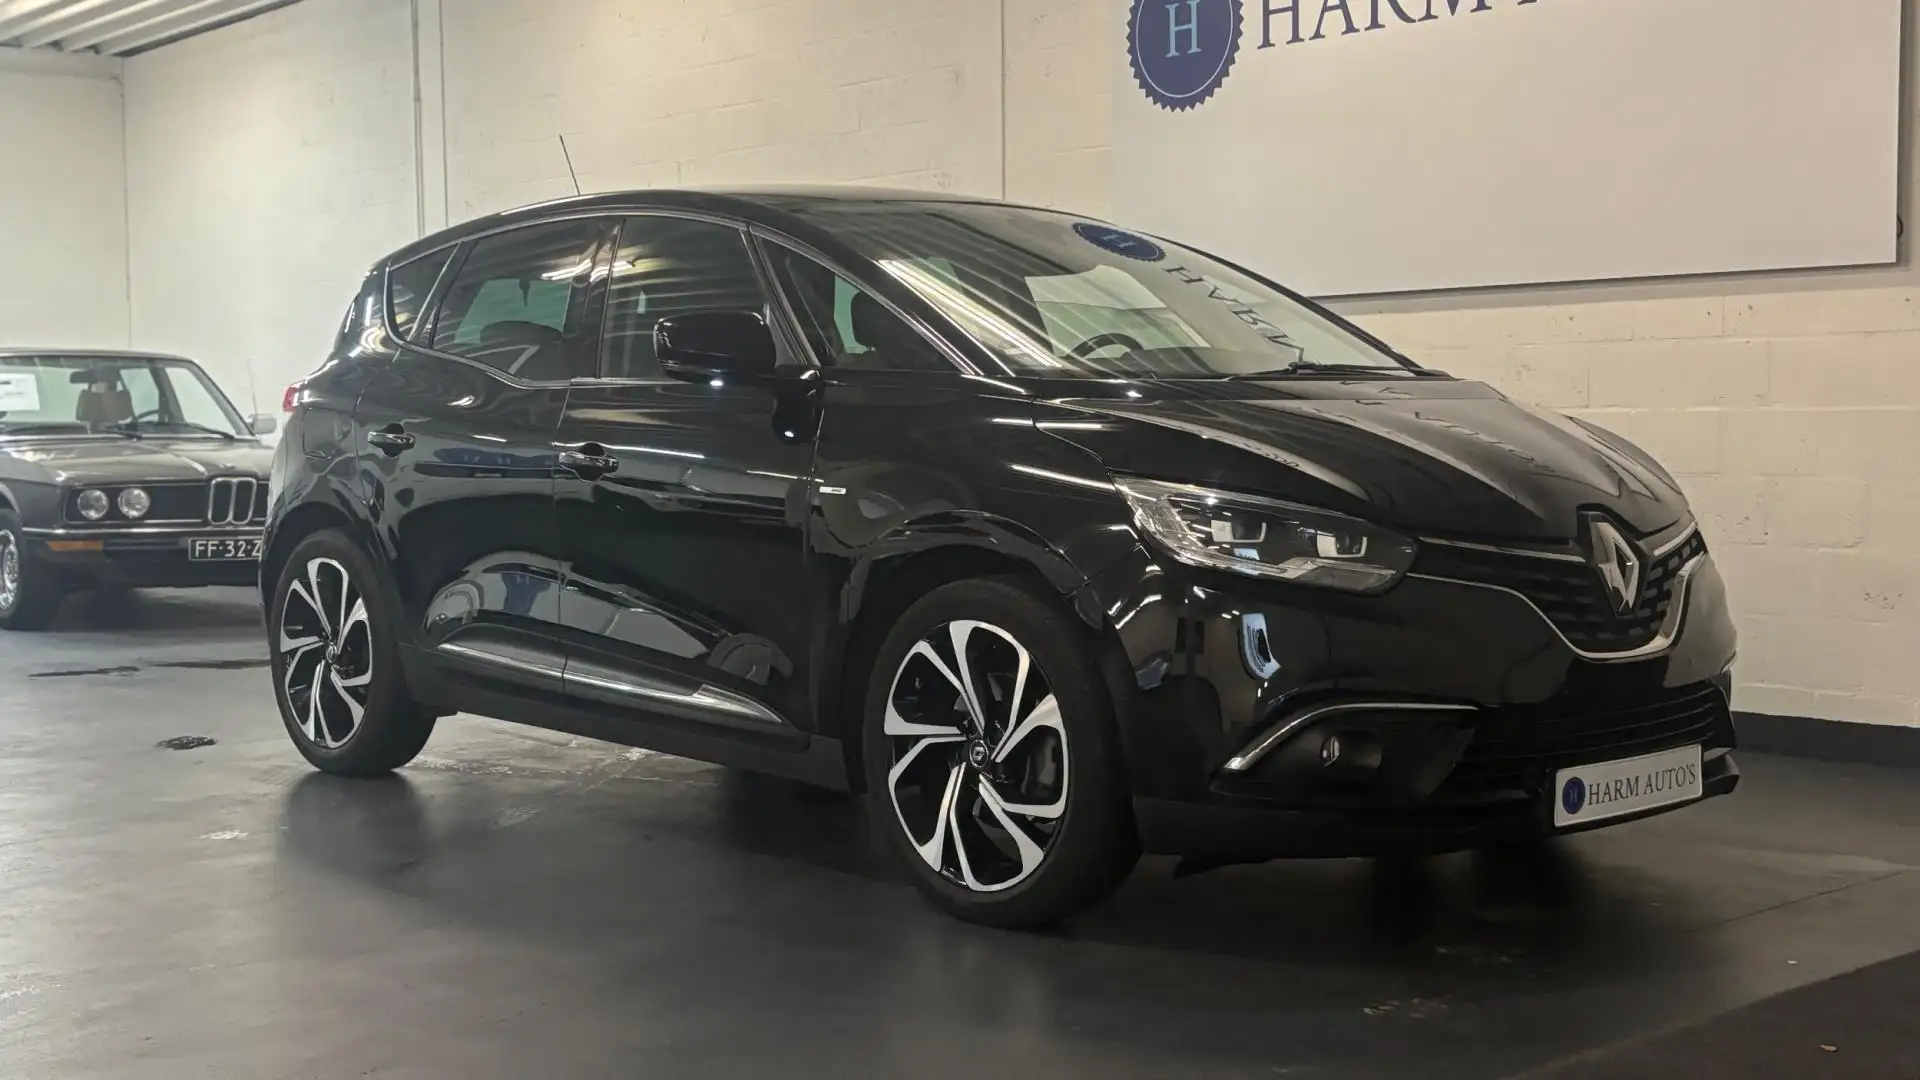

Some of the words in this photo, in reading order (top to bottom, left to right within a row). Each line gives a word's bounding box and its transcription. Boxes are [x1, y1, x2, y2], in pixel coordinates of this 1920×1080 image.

[1165, 0, 1202, 57] H
[1257, 0, 1492, 49] HA
[1587, 775, 1640, 805] HARM
[1644, 763, 1696, 795] AUTO'S
